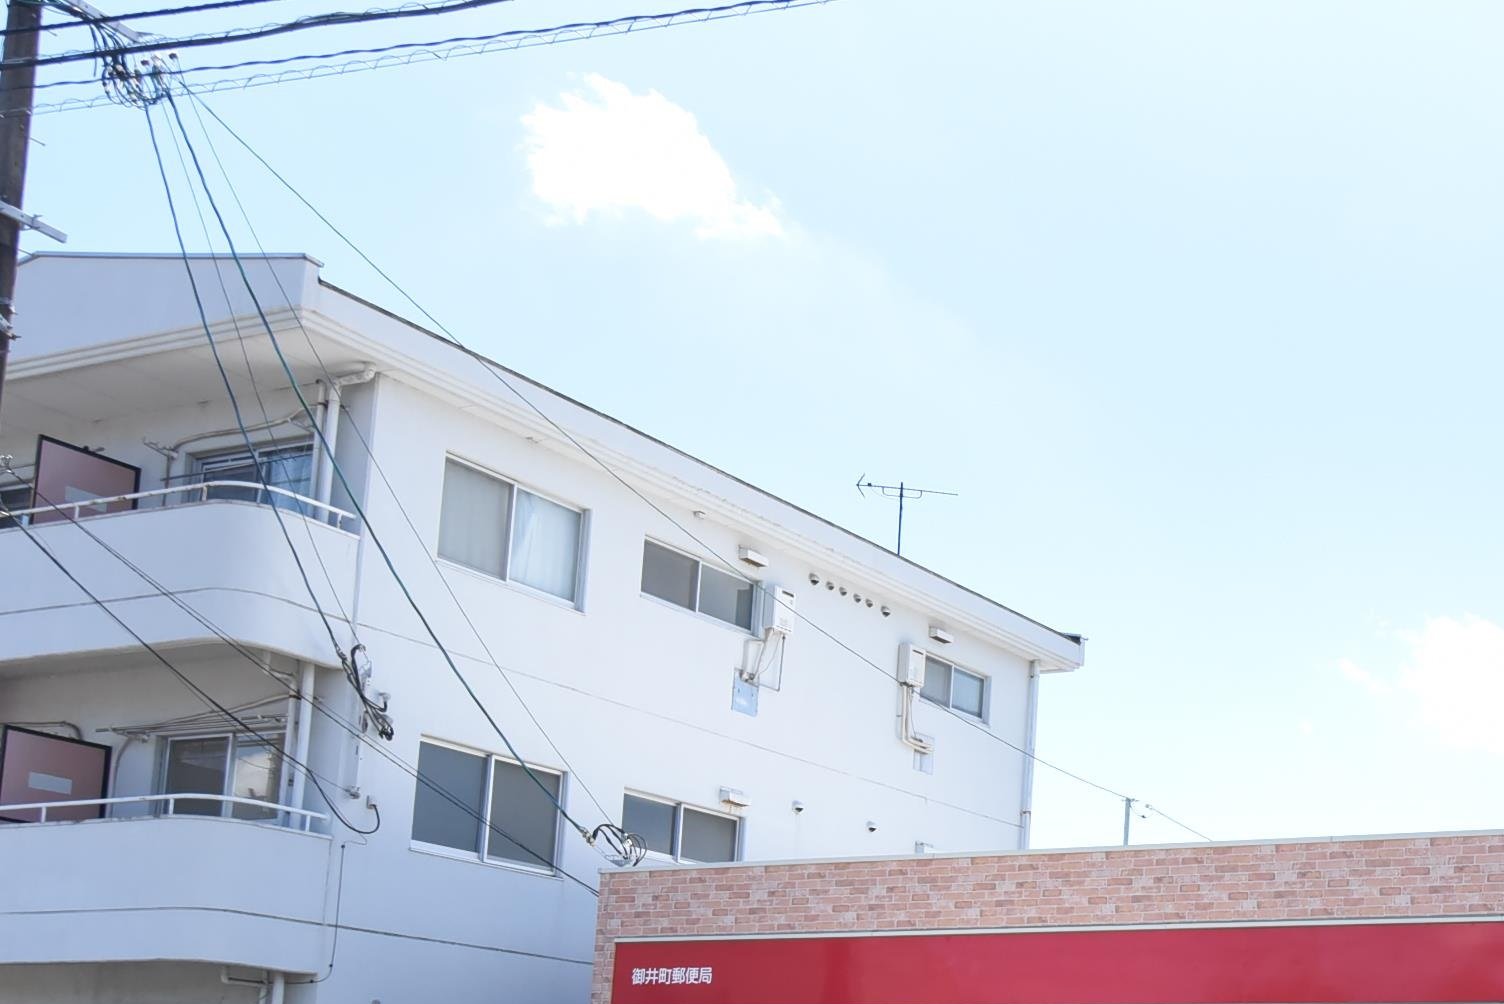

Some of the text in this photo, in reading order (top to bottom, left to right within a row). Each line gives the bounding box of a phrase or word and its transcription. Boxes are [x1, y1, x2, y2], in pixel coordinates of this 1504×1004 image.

[631, 966, 713, 985] 御井町郵便局
